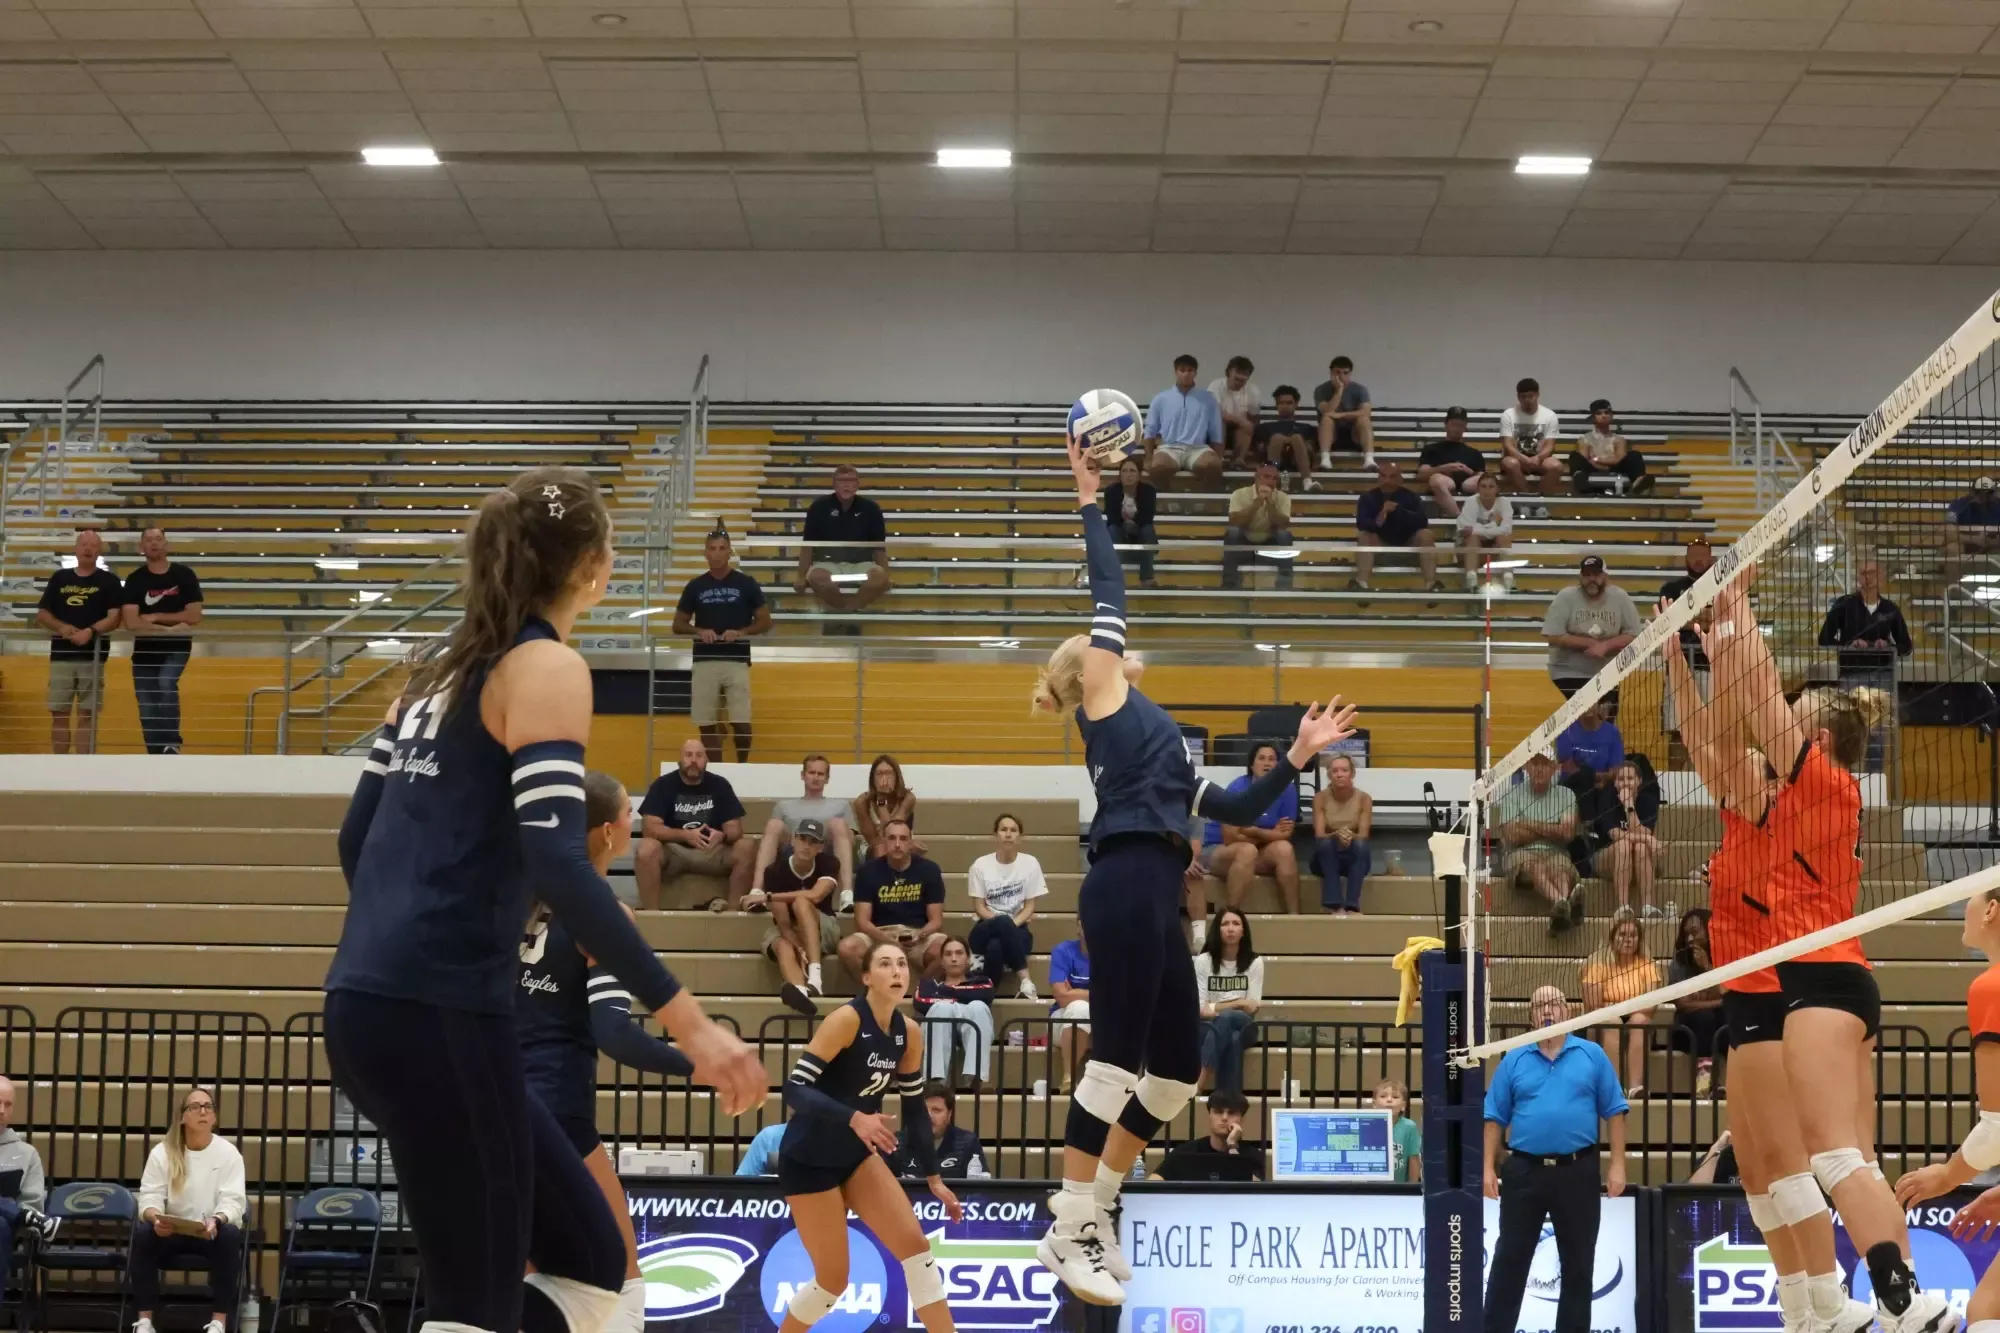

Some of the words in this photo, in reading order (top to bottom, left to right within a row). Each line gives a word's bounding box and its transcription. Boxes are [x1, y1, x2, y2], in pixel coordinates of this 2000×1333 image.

[1849, 405, 1886, 459] CLARION
[1884, 376, 1921, 425] GOLDEN
[1921, 340, 1957, 392] EAGLES
[1713, 548, 1739, 585] CLARION
[404, 747, 440, 783] Eagles
[675, 800, 714, 815] Volleyball
[521, 969, 559, 995] Eagles
[1210, 977, 1247, 990] CLARION
[1448, 1001, 1458, 1035] sports
[867, 1052, 896, 1069] Clarion
[859, 1072, 890, 1096] 21
[1132, 1220, 1213, 1268] EAGLE
[1230, 1221, 1302, 1268] PARK
[1448, 1214, 1462, 1261] sports
[937, 1264, 1052, 1301] SAC
[1228, 1274, 1288, 1287] Off-Campus
[1291, 1275, 1333, 1287] Housing
[1334, 1274, 1350, 1287] for
[1352, 1275, 1389, 1285] Clarion
[1364, 1288, 1373, 1299] &
[1376, 1288, 1420, 1301] Working
[1447, 1263, 1462, 1321] imports
[772, 1281, 882, 1314] NAA
